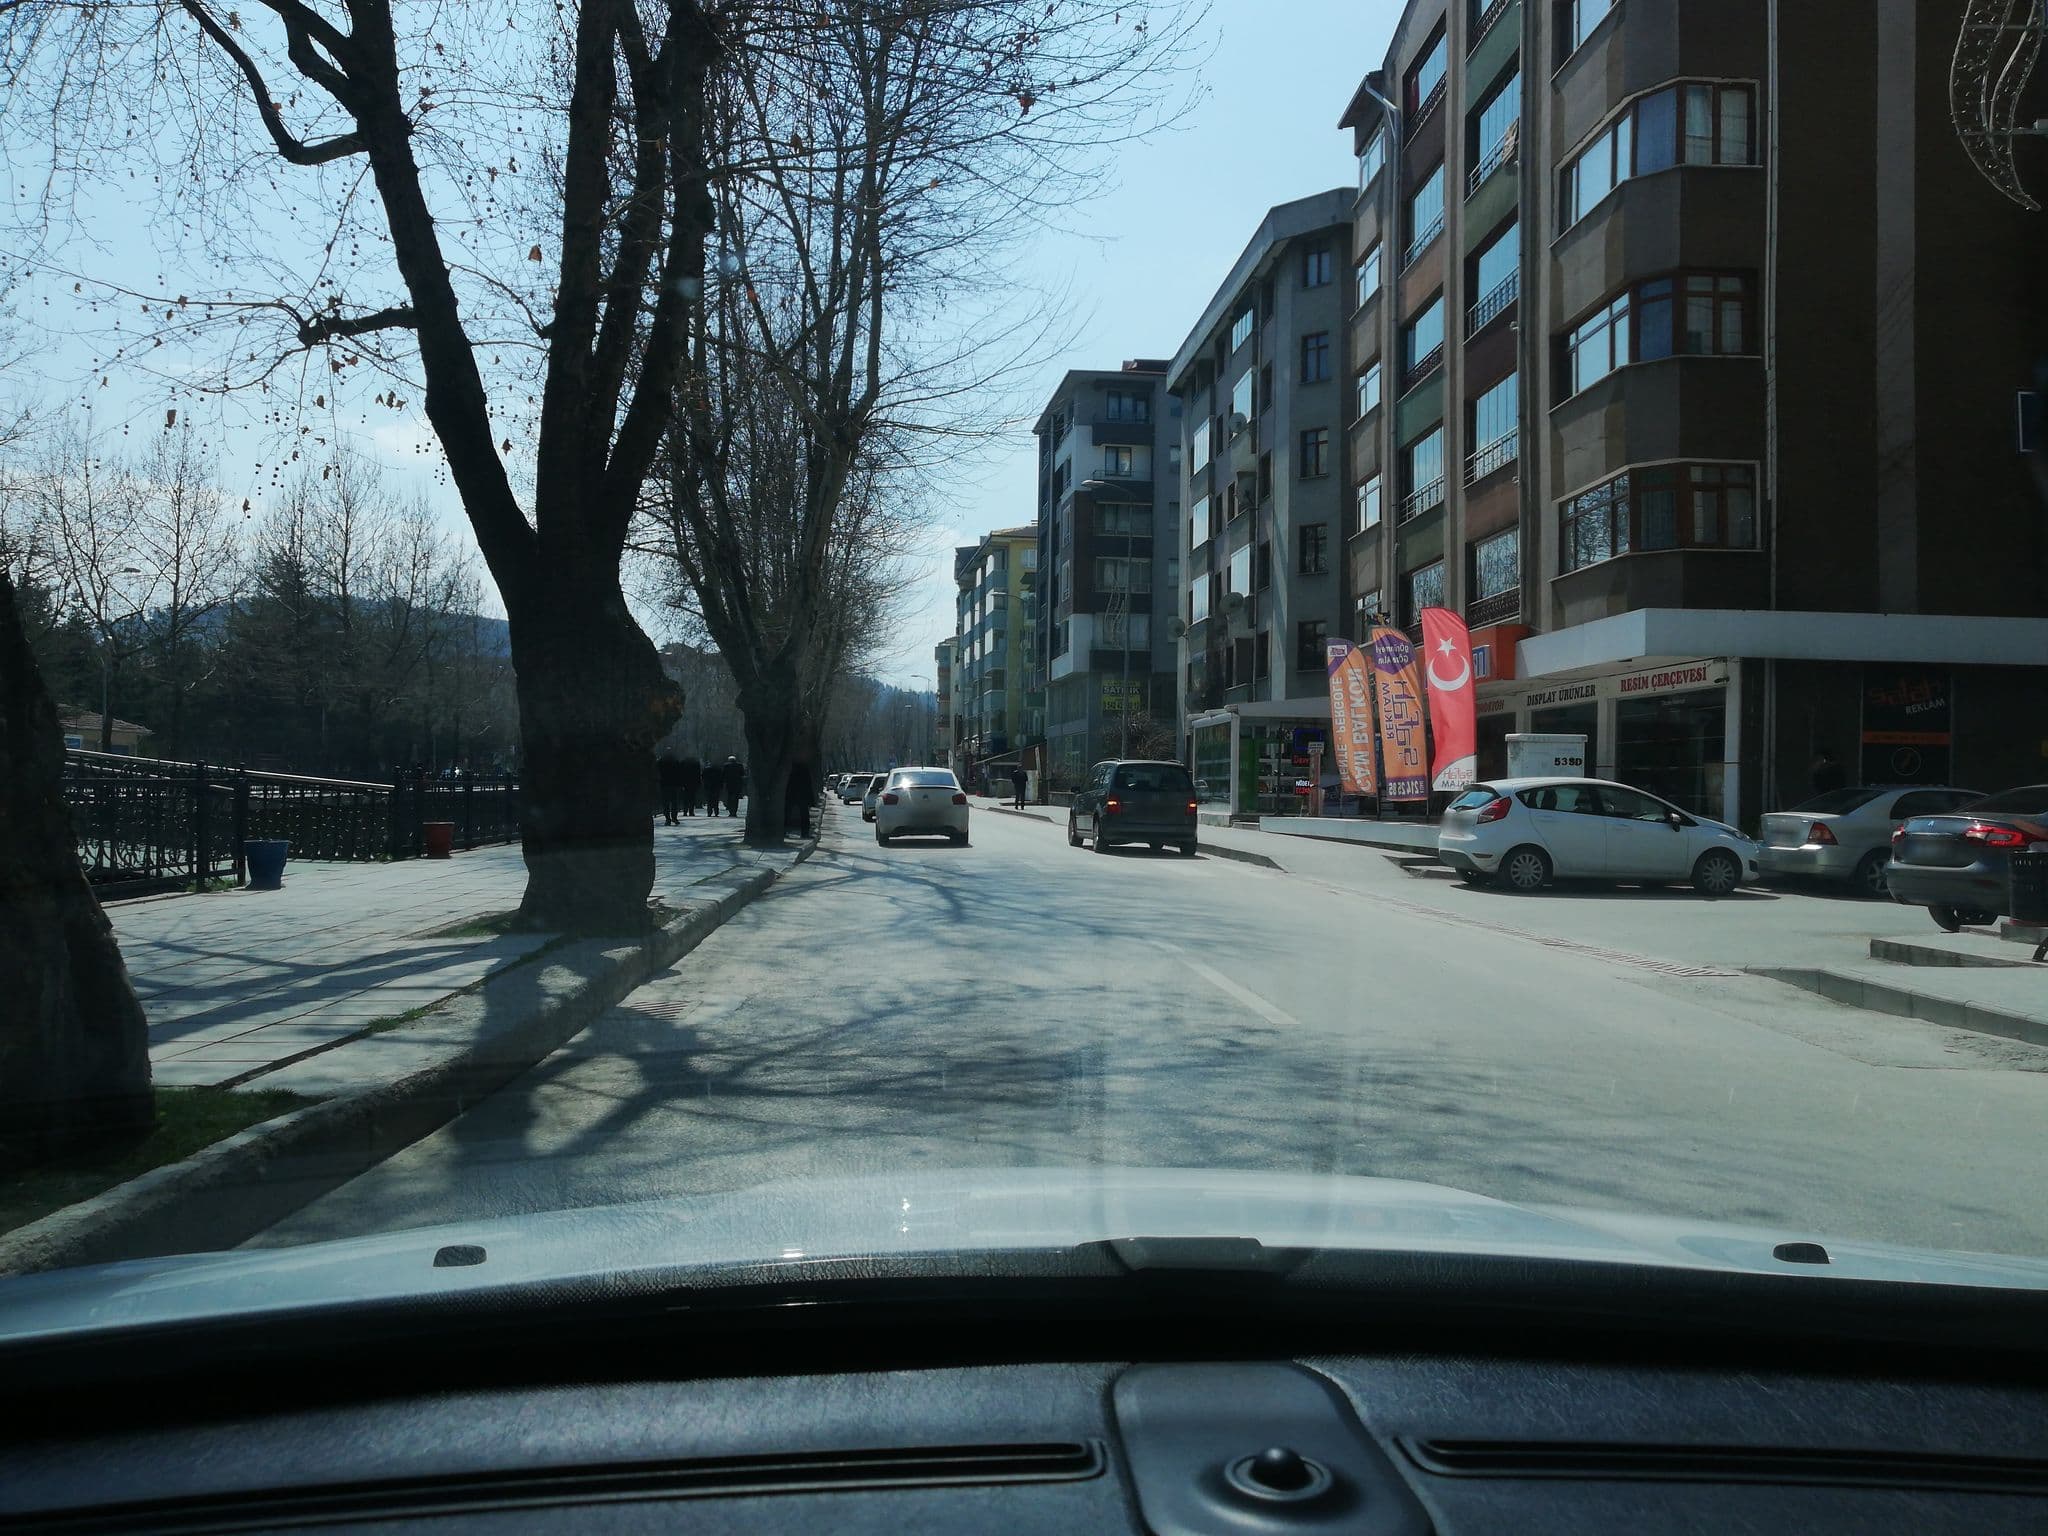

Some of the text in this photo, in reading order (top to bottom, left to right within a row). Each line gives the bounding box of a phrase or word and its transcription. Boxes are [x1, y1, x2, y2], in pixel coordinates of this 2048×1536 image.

[1620, 663, 1707, 692] RESİM ÇERÇEVESİ
[1103, 686, 1141, 695] SATIIK
[1527, 690, 1557, 706] DISPLAY
[1905, 698, 1945, 715] REKLAM
